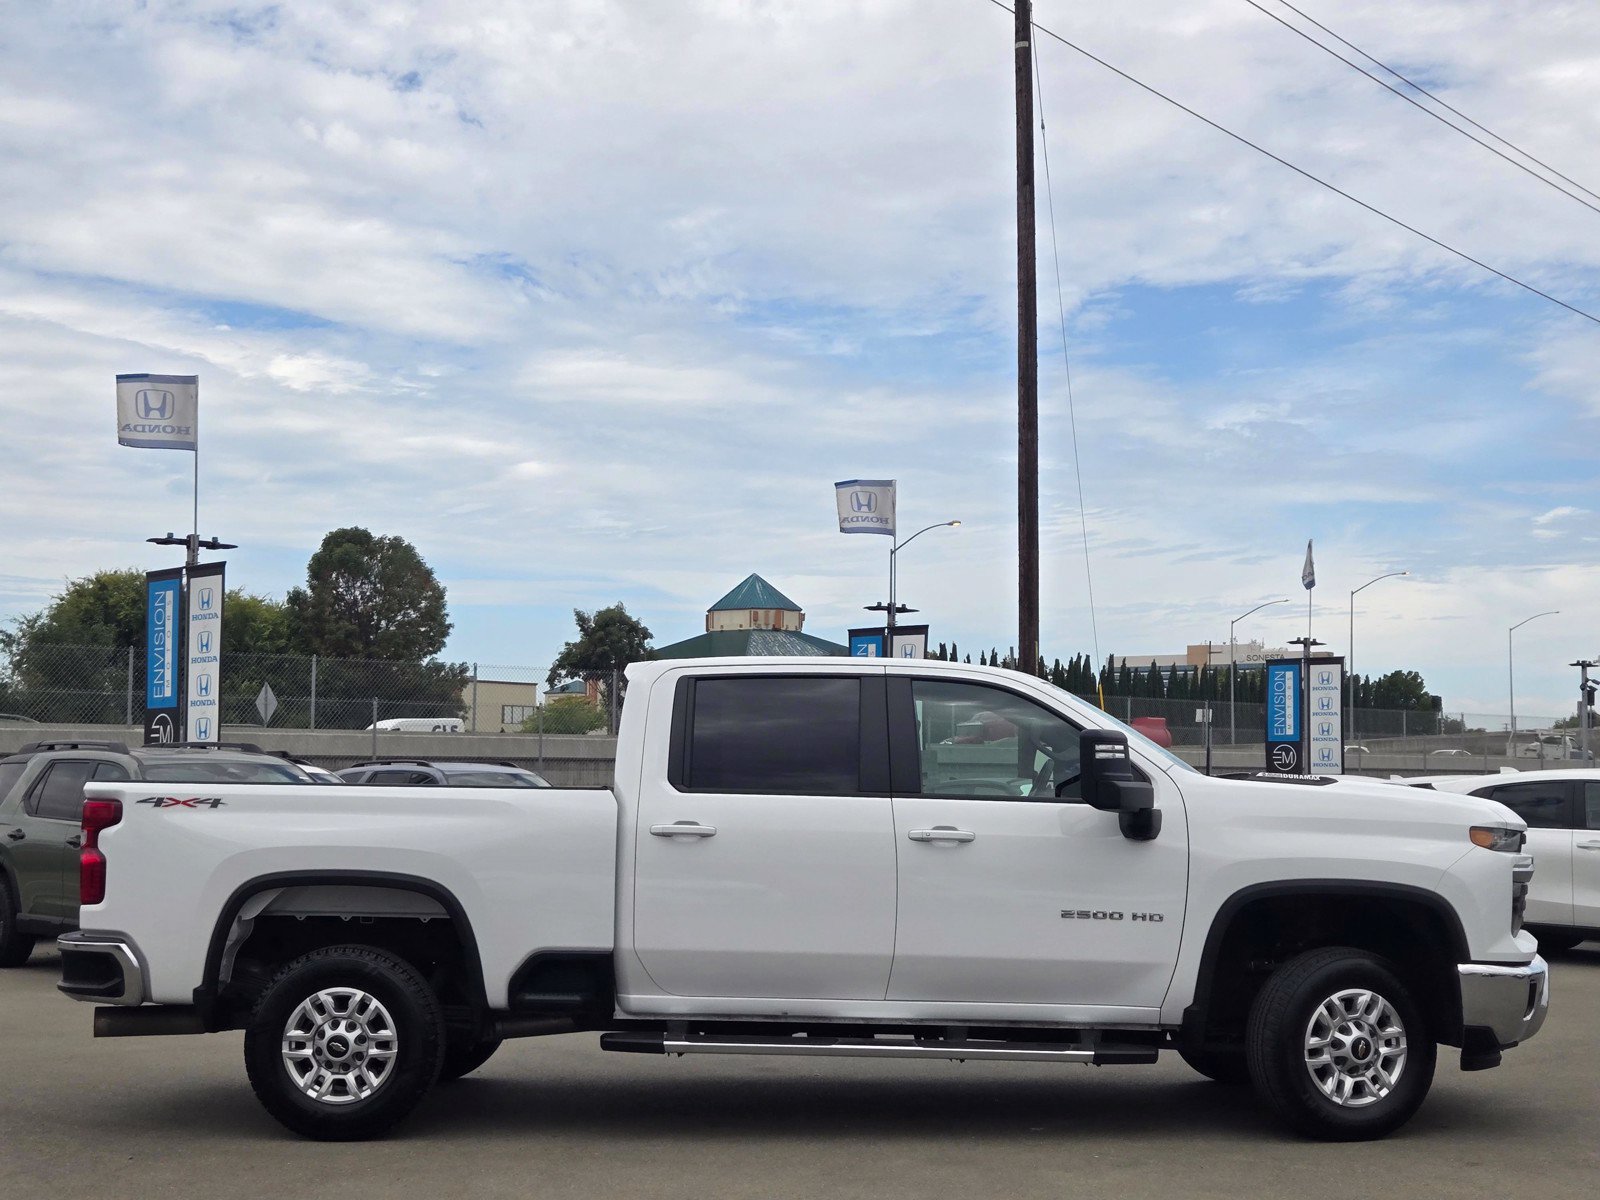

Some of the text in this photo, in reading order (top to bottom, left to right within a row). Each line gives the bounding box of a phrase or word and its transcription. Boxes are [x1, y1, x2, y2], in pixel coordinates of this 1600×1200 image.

[191, 612, 219, 621] HONDA
[153, 591, 166, 698] ENVISION
[190, 655, 218, 664] HONDA
[1246, 653, 1285, 662] SONESTA
[190, 699, 217, 707] HONDA
[1273, 671, 1286, 736] ENVISION
[1283, 773, 1321, 781] DURAMAX
[1060, 909, 1164, 922] 2500 HD
